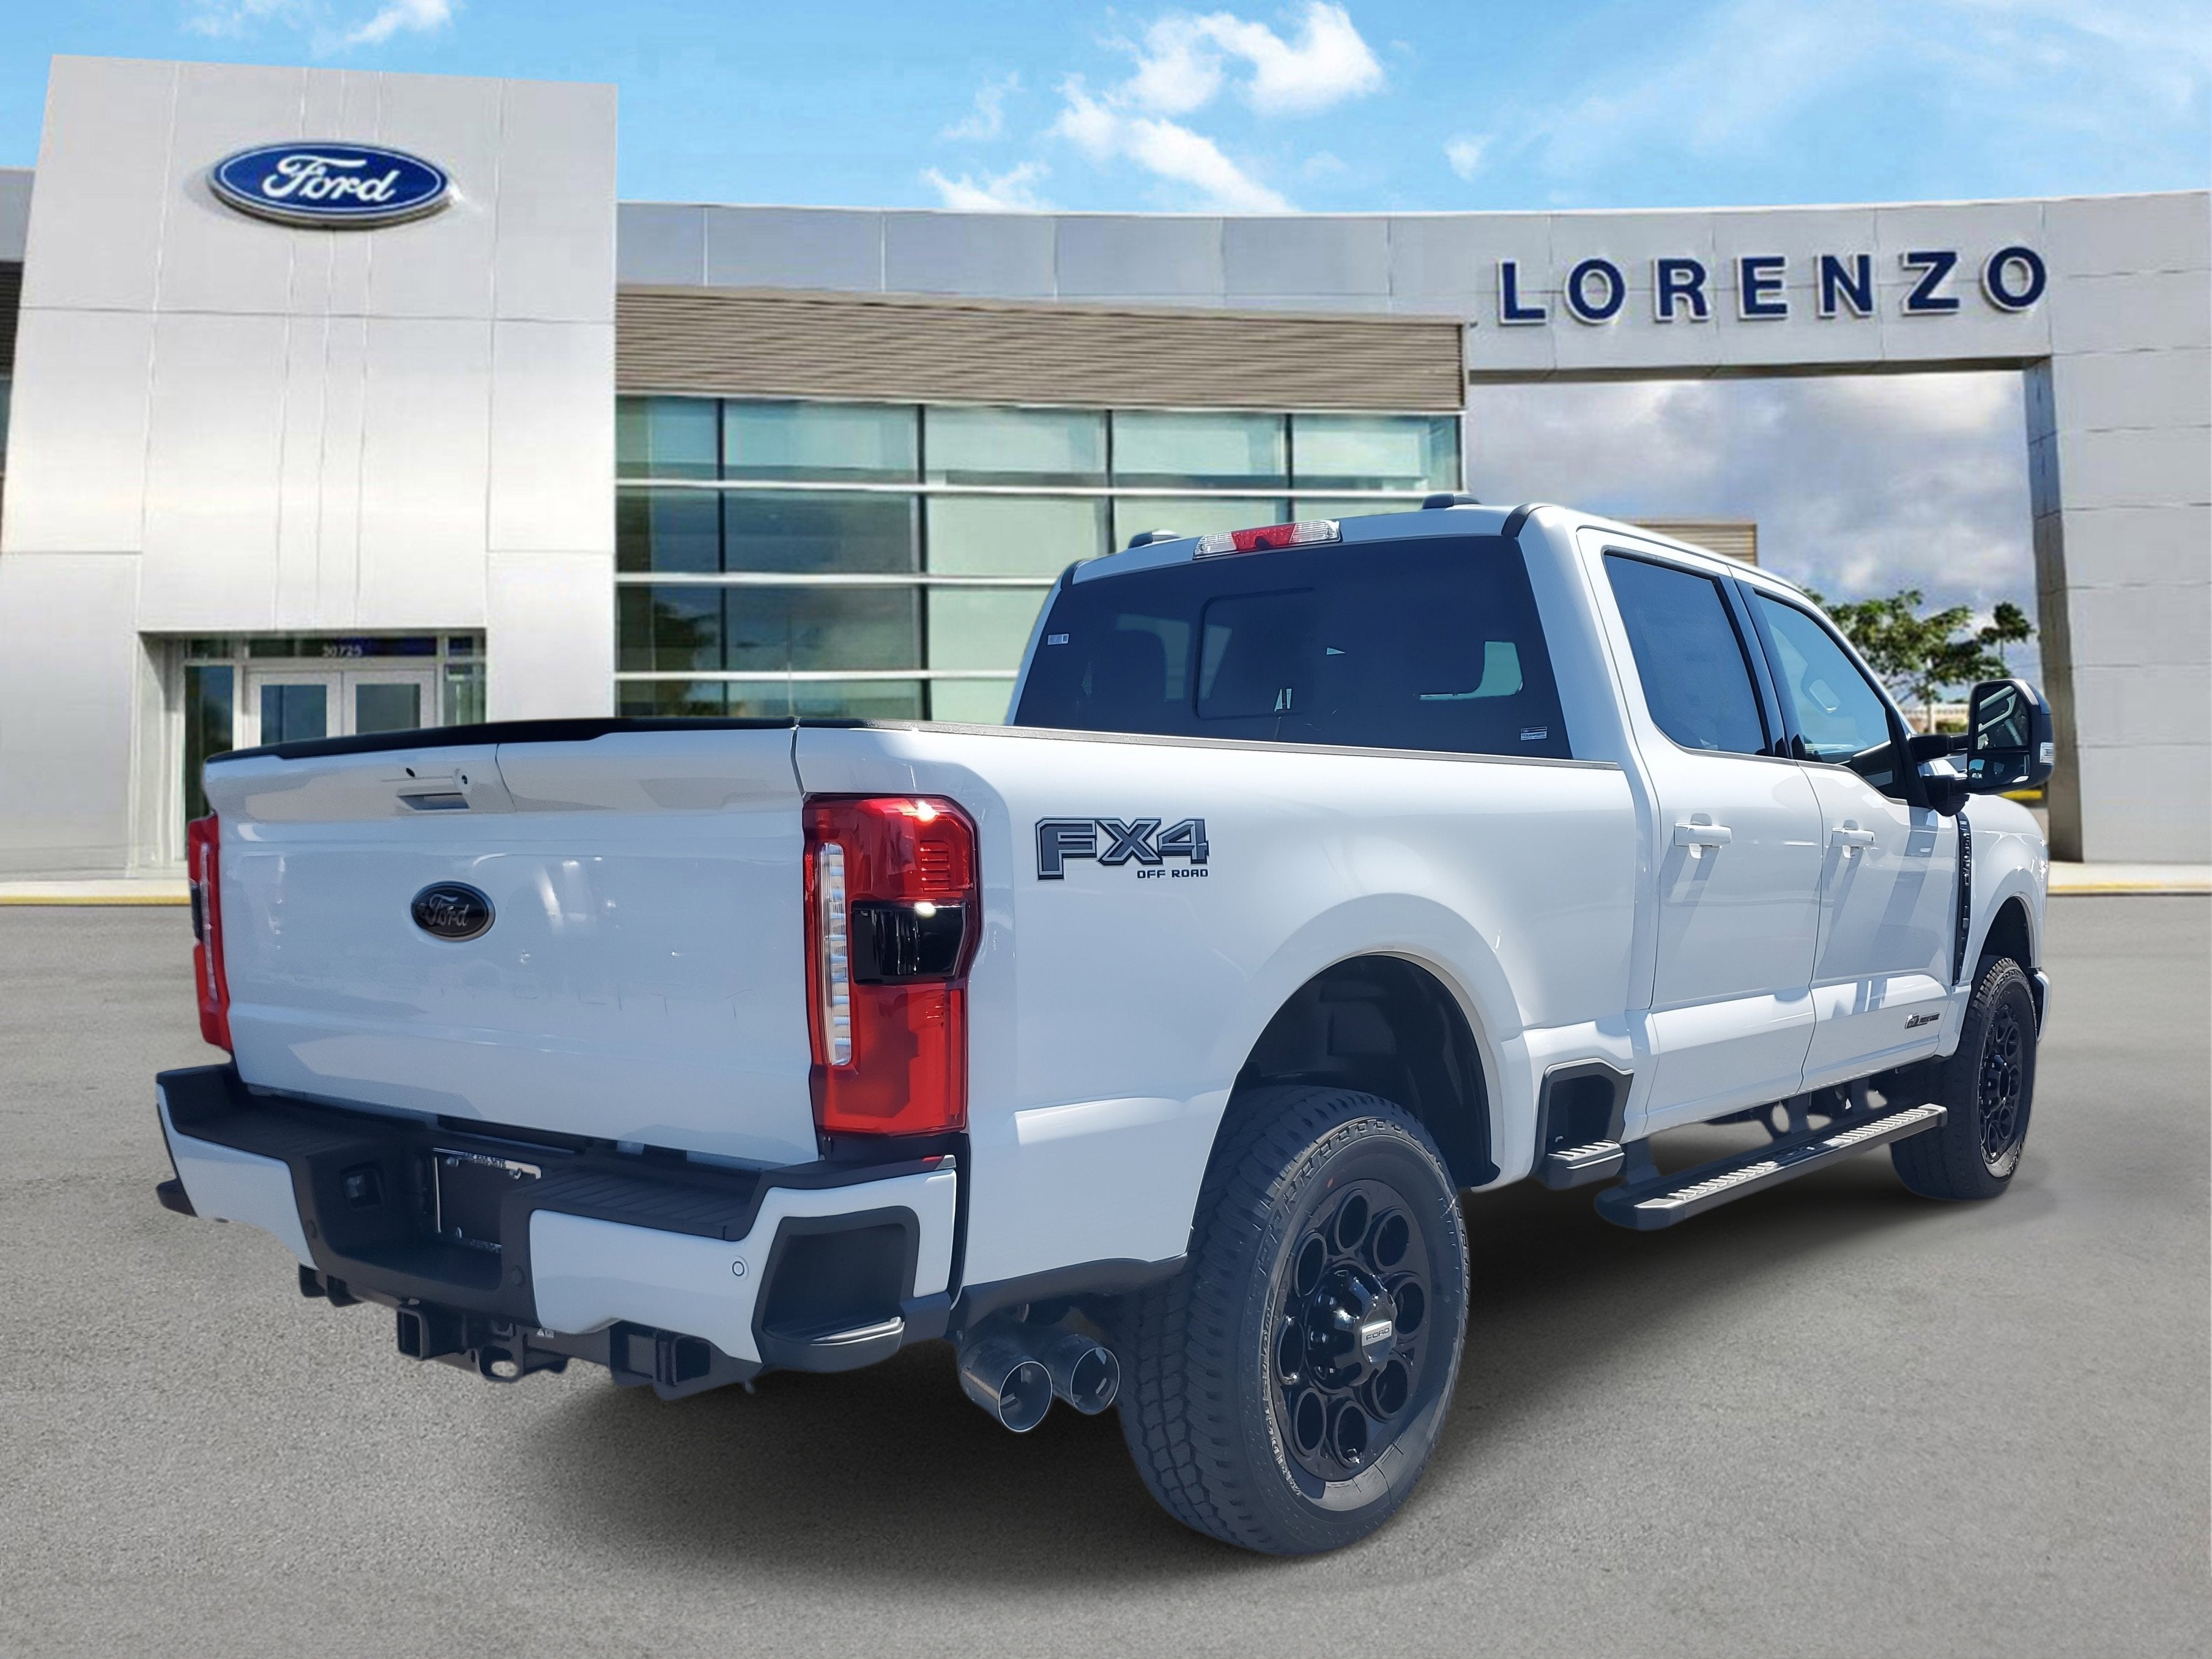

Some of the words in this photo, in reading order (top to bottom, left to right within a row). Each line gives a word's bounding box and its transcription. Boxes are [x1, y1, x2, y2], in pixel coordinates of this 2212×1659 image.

[262, 155, 401, 201] Ford
[1499, 246, 2047, 324] LORENZO
[1035, 816, 1210, 881] FX4
[1137, 869, 1166, 878] OFF
[1171, 869, 1209, 878] ROAD
[426, 893, 469, 926] Ford
[1366, 1327, 1390, 1340] FORD
